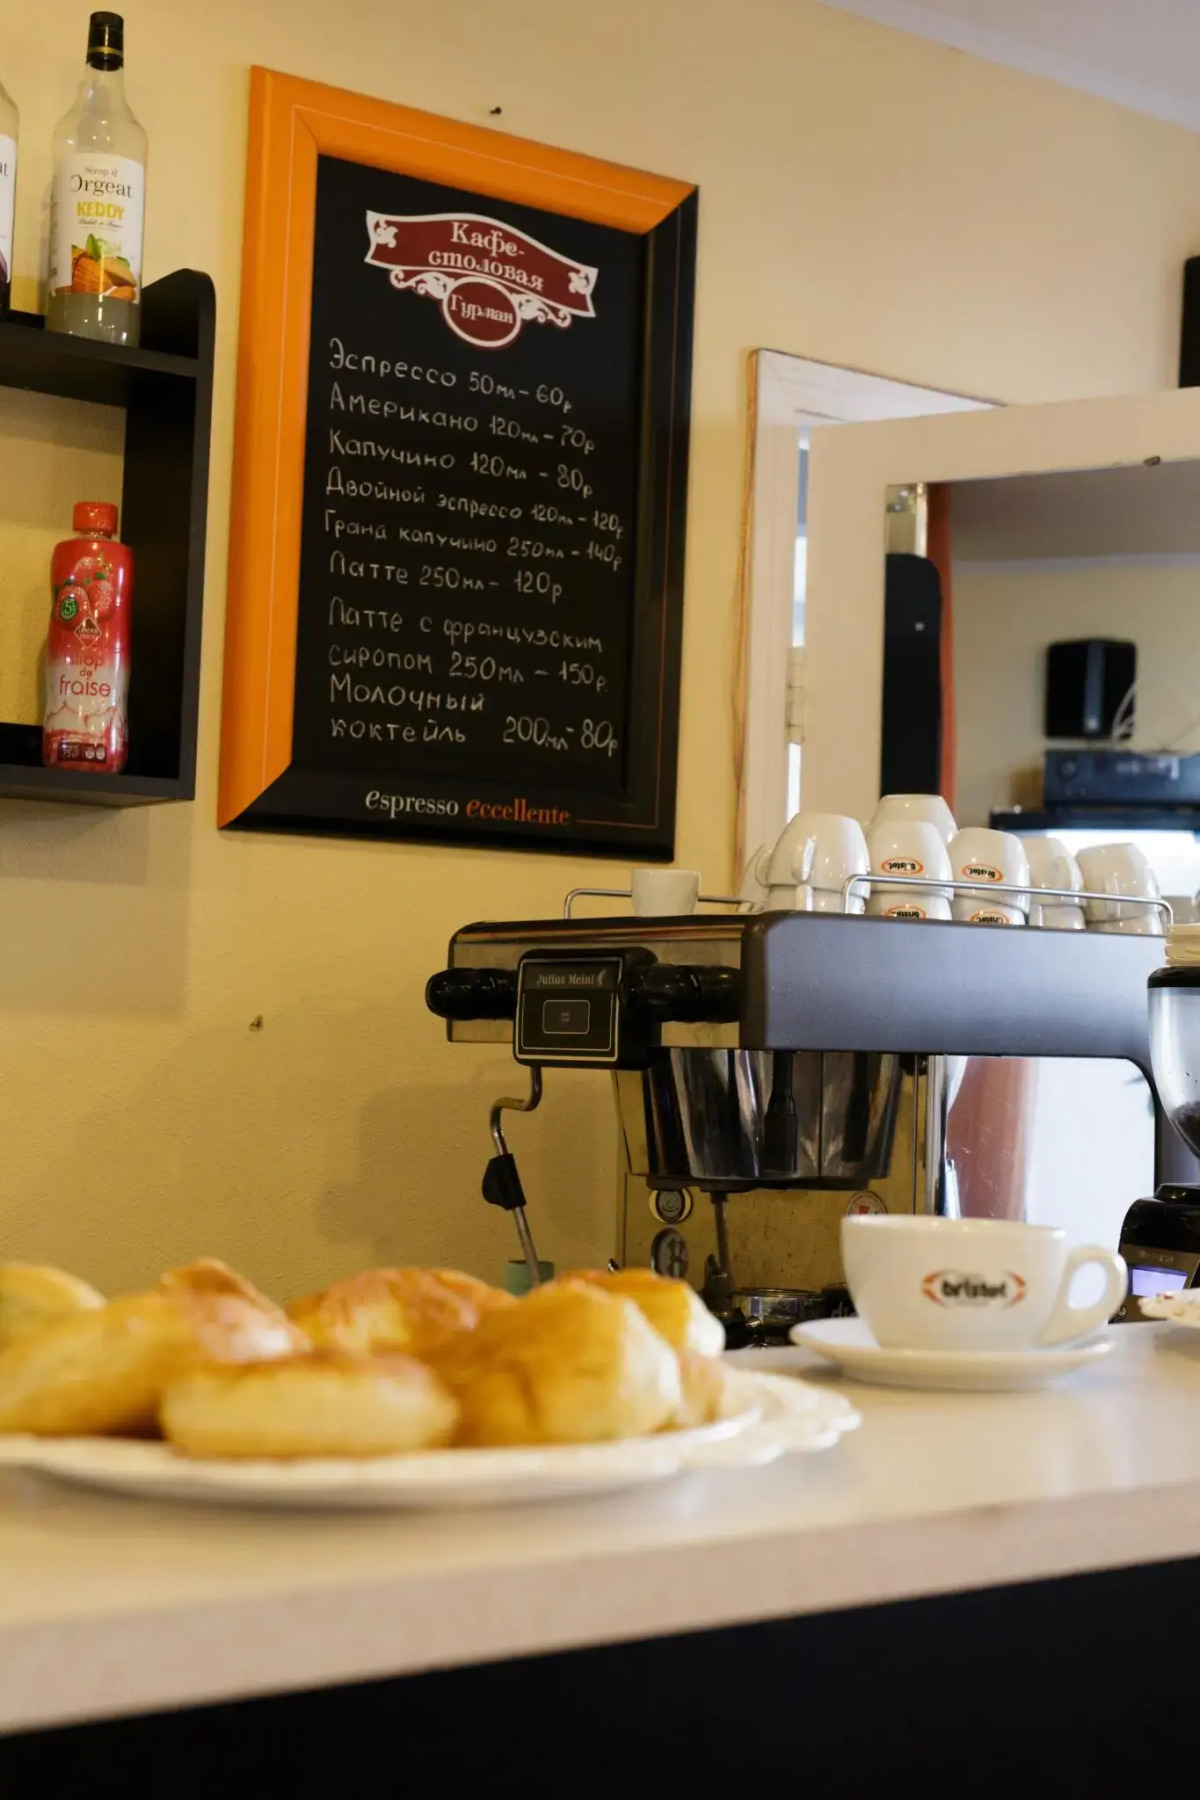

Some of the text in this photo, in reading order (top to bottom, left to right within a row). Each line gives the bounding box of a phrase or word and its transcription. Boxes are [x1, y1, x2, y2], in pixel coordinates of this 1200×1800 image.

[70, 174, 133, 198] Orgeat
[77, 201, 125, 220] KEDDY
[450, 221, 525, 257] Кафе-
[428, 250, 545, 291] столовая
[450, 294, 513, 324] Гурман
[329, 337, 457, 387] Эспрессо
[330, 381, 478, 431] Американо
[329, 427, 455, 469] Капучино
[326, 466, 426, 503] Двойной
[436, 494, 523, 520] эспрессо
[400, 527, 497, 553] капучино
[330, 550, 408, 584] Латте
[514, 570, 563, 604] 120р
[329, 596, 602, 653] Латте с французским
[328, 644, 432, 674] сиропом
[60, 674, 110, 697] fraise
[330, 673, 485, 711] Молочный
[331, 718, 466, 743] коктейль
[365, 789, 570, 825] espresso eccellente
[536, 973, 595, 987] Julius Meinl
